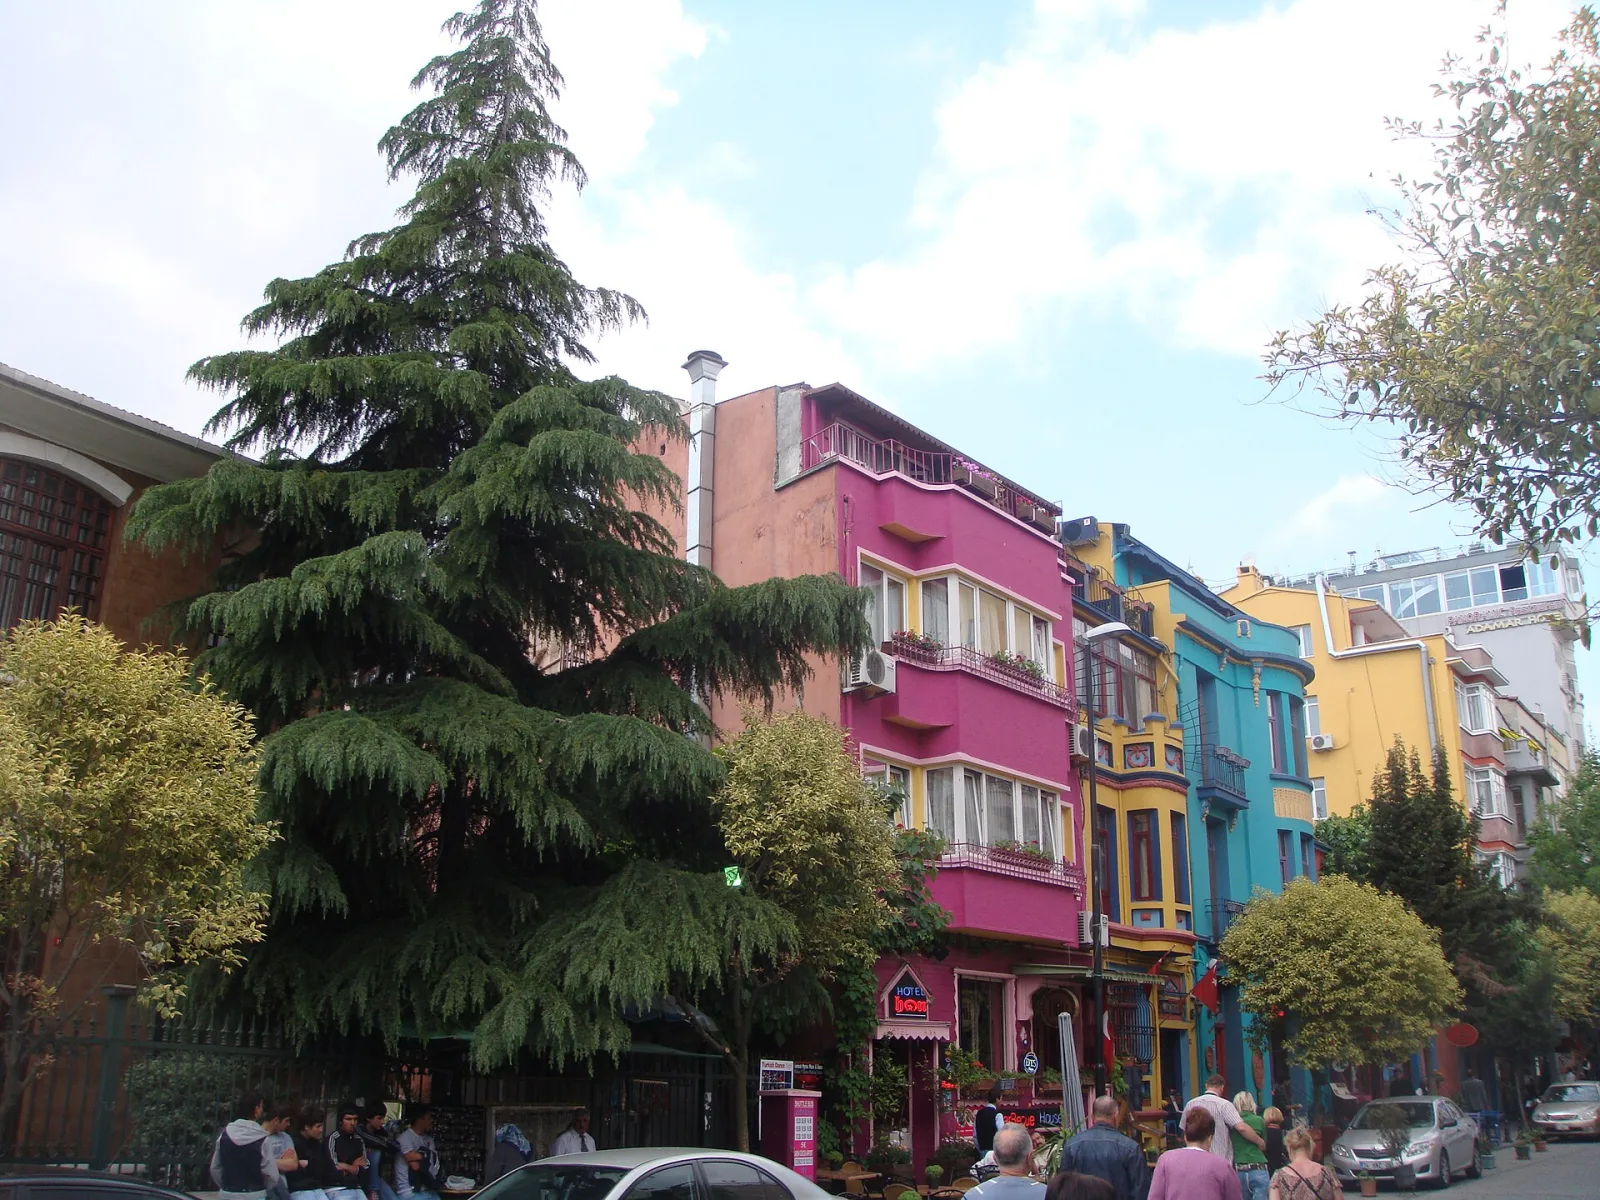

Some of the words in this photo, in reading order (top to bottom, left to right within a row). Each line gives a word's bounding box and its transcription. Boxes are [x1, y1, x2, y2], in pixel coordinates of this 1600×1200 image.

[1448, 607, 1505, 626] PANORAMIC
[1466, 618, 1523, 634] ADAMAR
[897, 986, 926, 996] HOTEL
